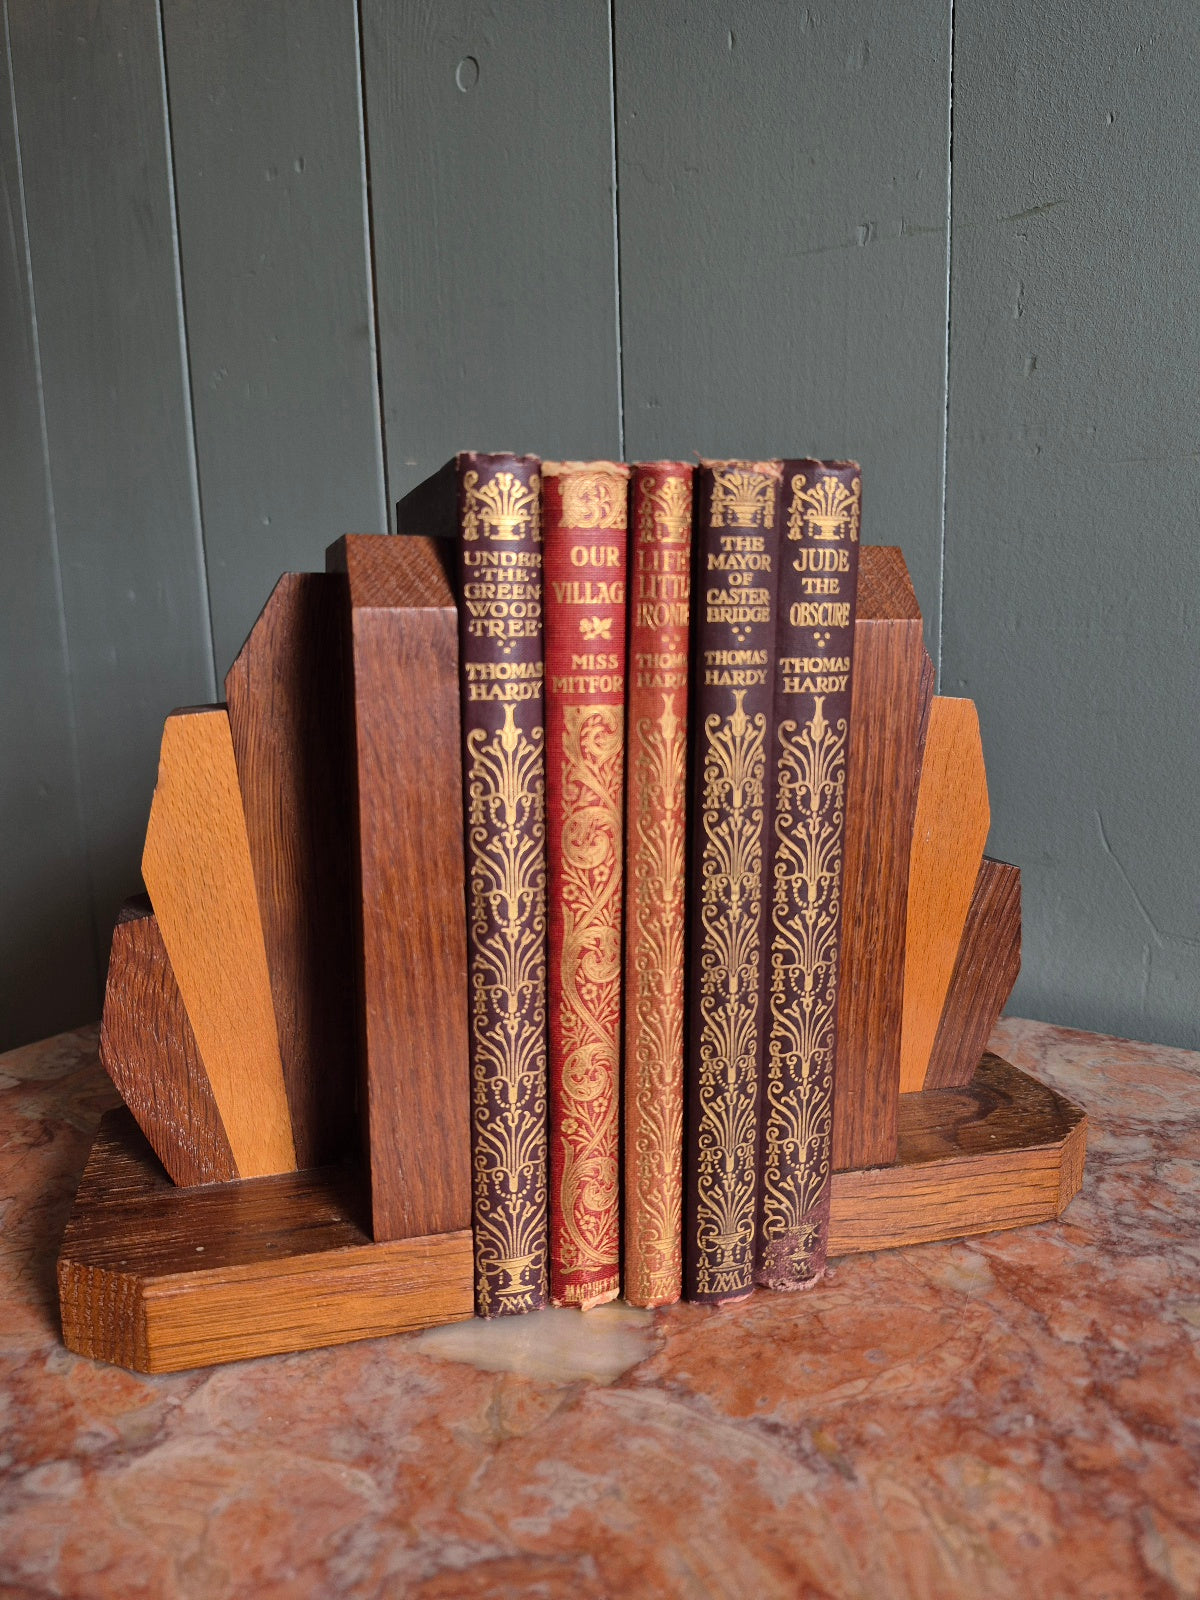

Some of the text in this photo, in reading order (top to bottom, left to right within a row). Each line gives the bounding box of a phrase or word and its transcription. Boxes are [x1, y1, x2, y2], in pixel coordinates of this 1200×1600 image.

[720, 536, 765, 552] THE
[464, 551, 541, 567] UNDER
[570, 546, 621, 567] OUR
[707, 553, 772, 572] MAYOR
[793, 548, 850, 572] JUDE
[481, 568, 529, 582] THE
[728, 572, 754, 586] OF
[464, 583, 541, 600] GREEN
[552, 581, 624, 604] VILLAG
[638, 574, 690, 599] LITTL
[801, 577, 840, 595] THE
[706, 588, 770, 606] CASTER
[466, 601, 541, 617] WOOD
[706, 606, 771, 624] BRIDGE
[789, 602, 850, 628] OBSCURE
[470, 619, 539, 640] TREE
[571, 654, 618, 670] MISS
[635, 652, 687, 669] THOM
[704, 650, 768, 666] THOMAS
[779, 656, 850, 674] THOMAS
[465, 661, 543, 680] THOMAS
[704, 669, 768, 686] HARDY
[552, 675, 623, 693] MITFOR
[636, 672, 687, 690] HARD
[782, 675, 849, 694] HARDY
[469, 681, 543, 701] HARDY
